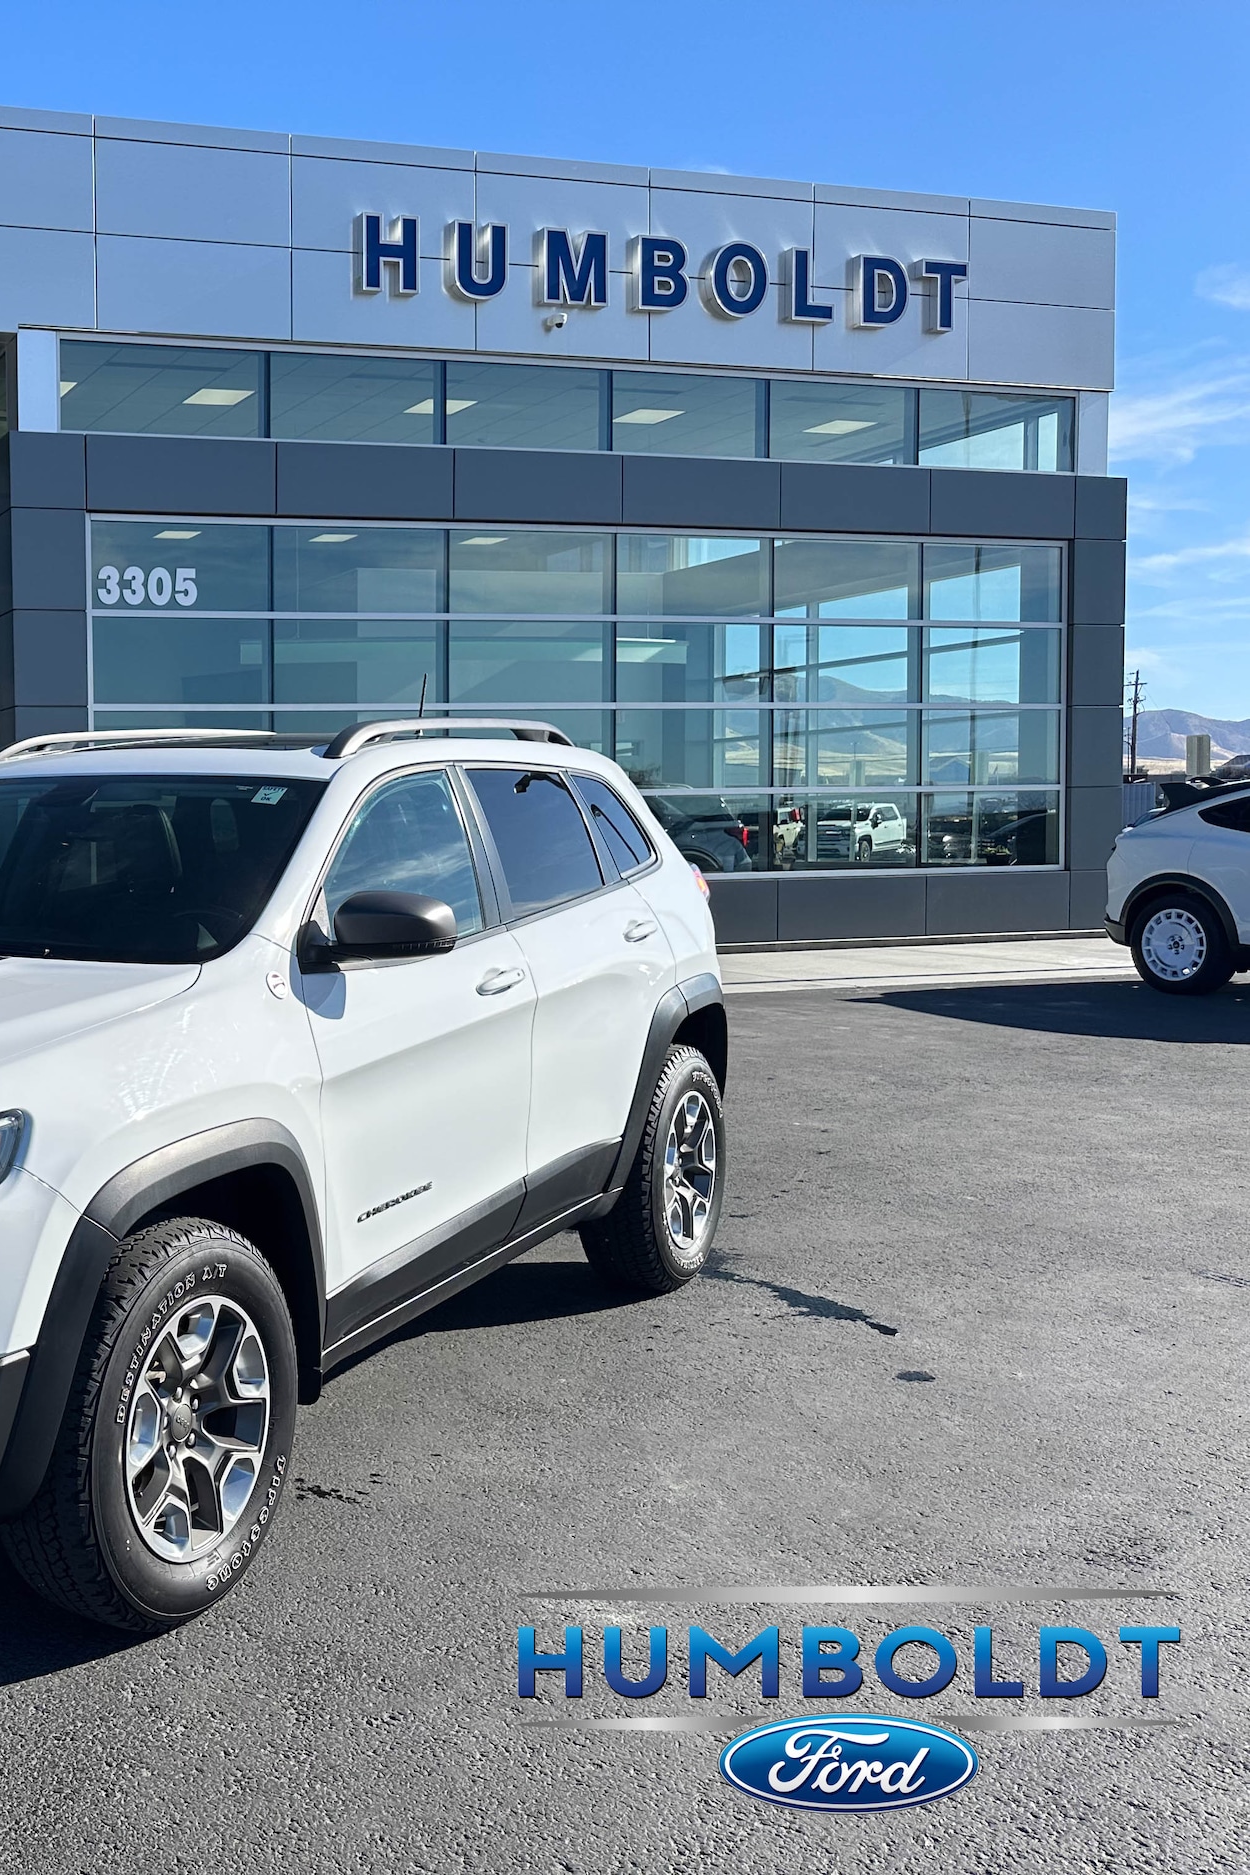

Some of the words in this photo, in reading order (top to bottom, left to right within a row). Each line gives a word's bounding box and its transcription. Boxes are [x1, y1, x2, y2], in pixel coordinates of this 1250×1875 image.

[353, 211, 969, 334] HUMBOLDT
[97, 565, 198, 607] 3305
[116, 1271, 196, 1424] DESTINATION
